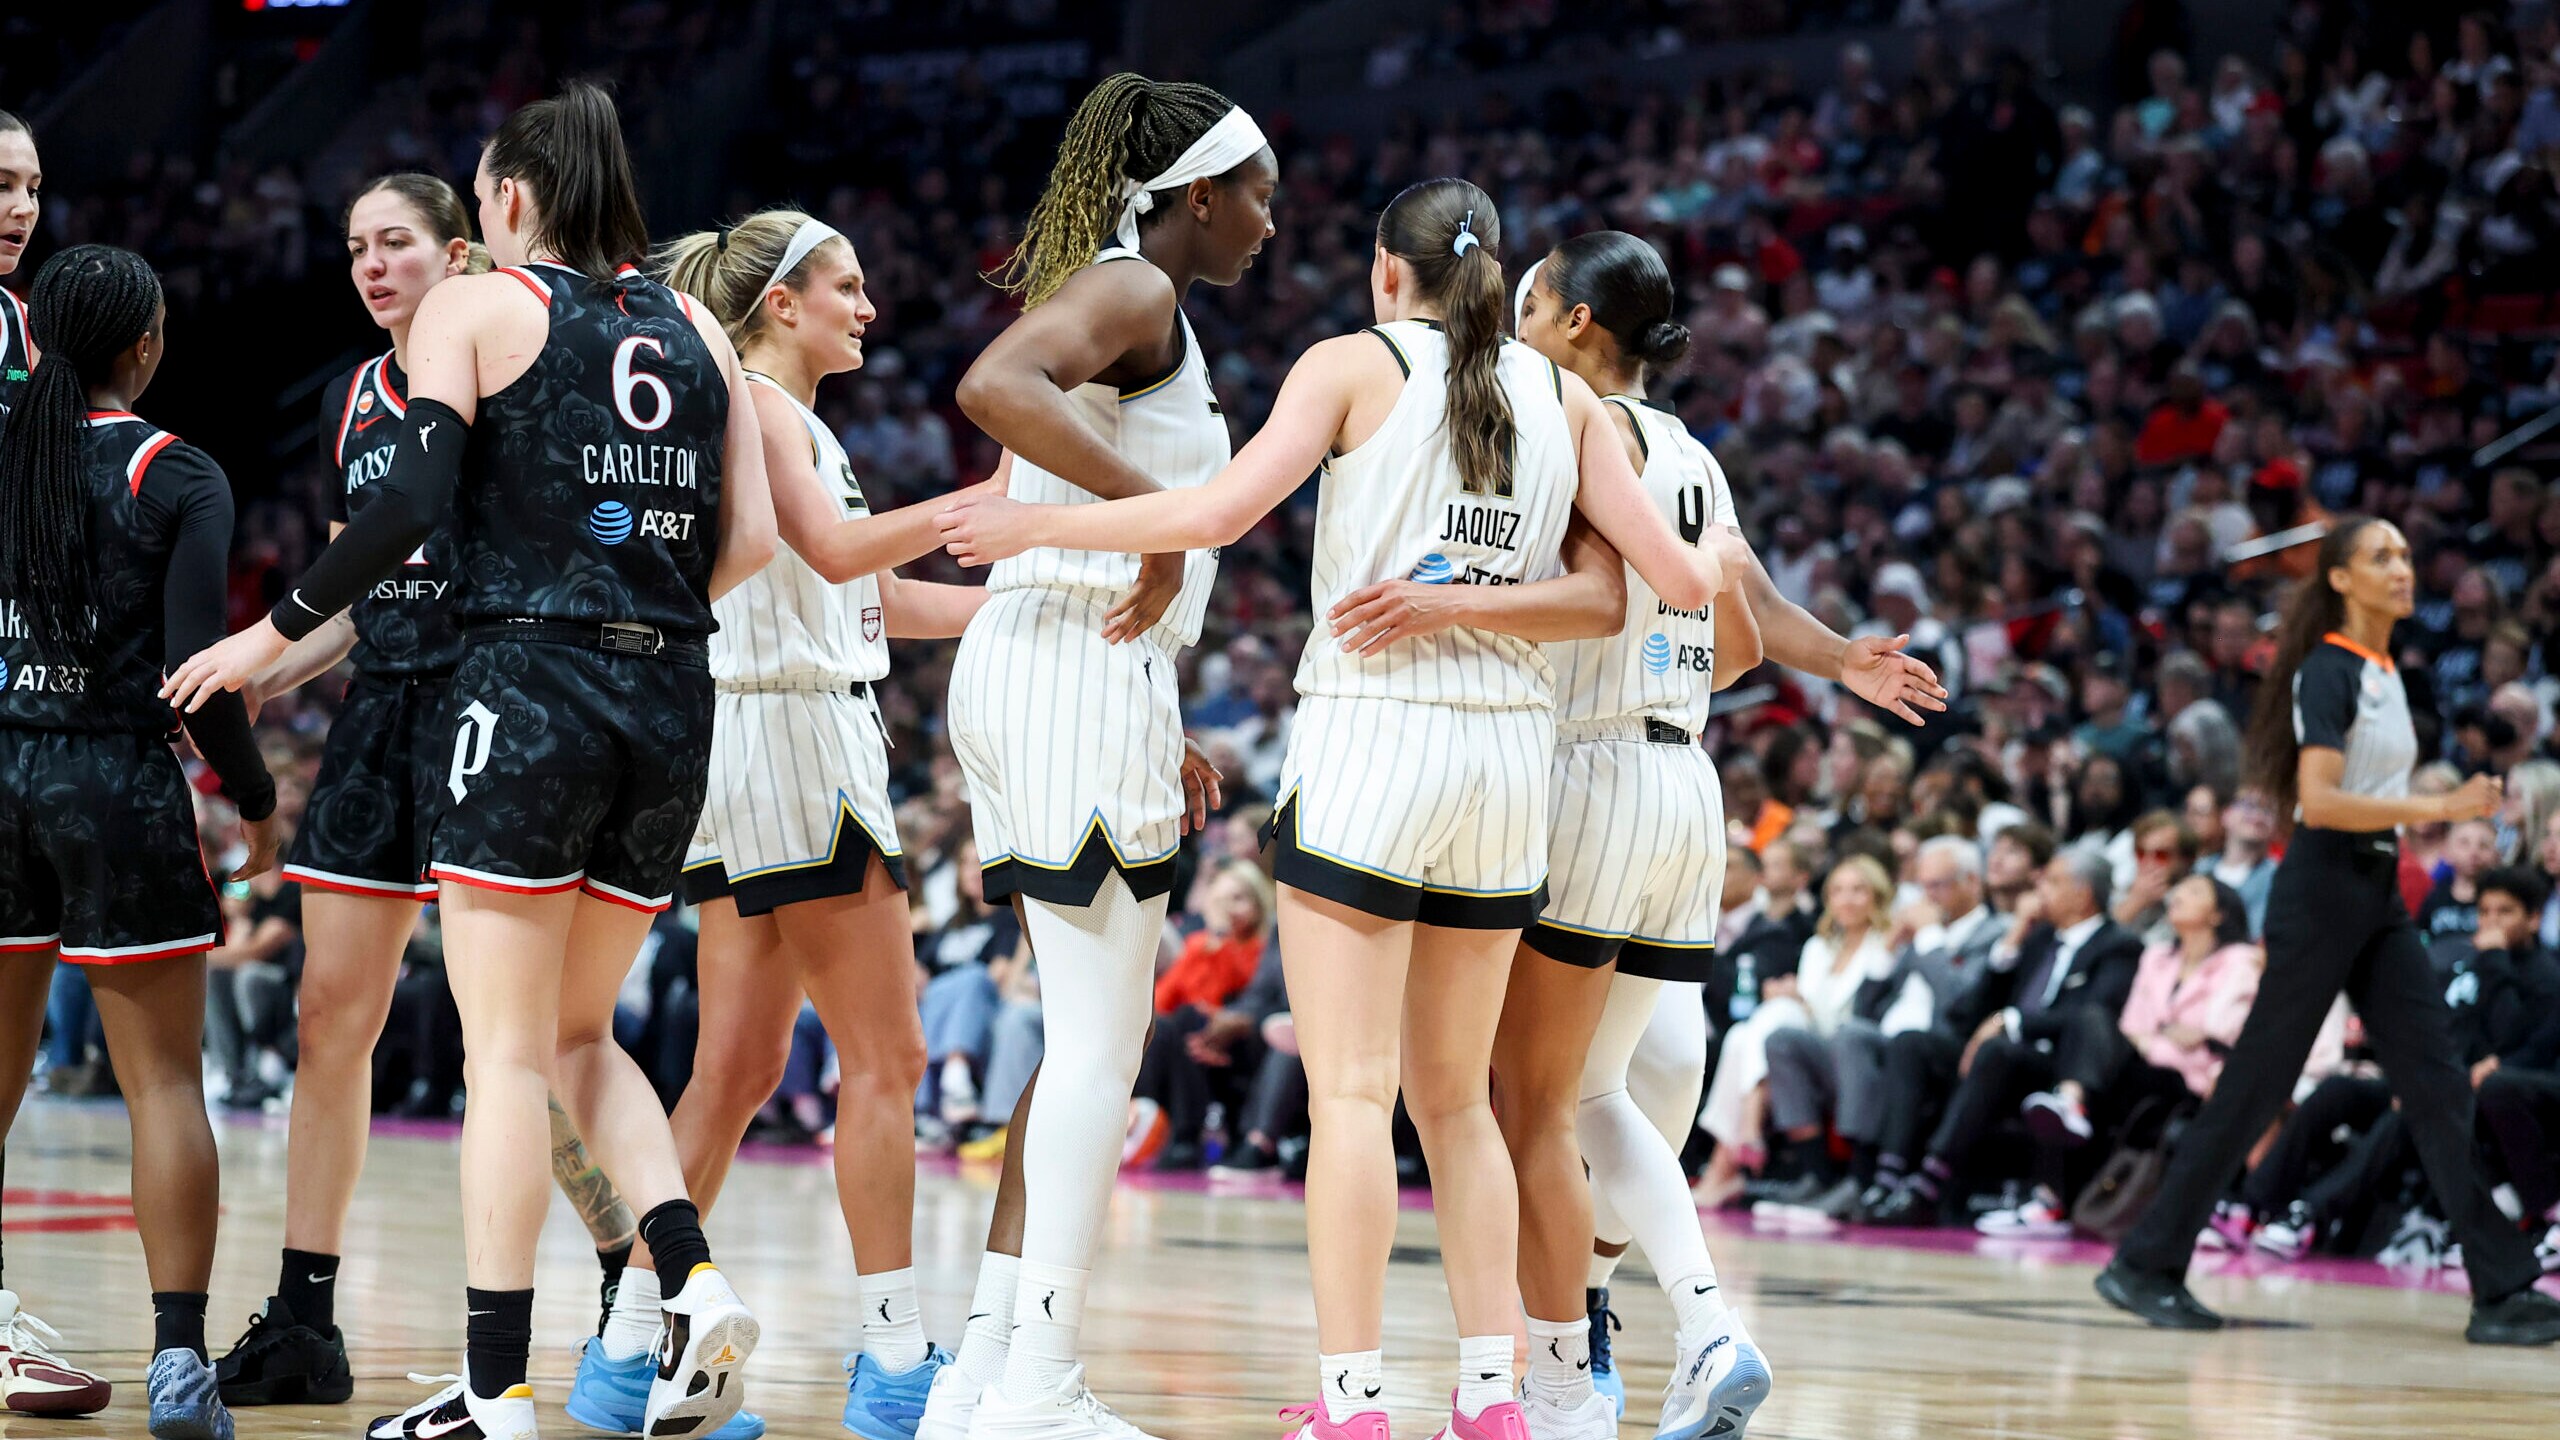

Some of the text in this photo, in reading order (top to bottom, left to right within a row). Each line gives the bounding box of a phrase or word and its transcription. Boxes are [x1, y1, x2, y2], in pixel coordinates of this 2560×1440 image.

[612, 335, 674, 432] 6
[583, 443, 697, 490] CARLETON
[639, 509, 695, 541] AT&T
[1440, 504, 1521, 551] JAQUEZ
